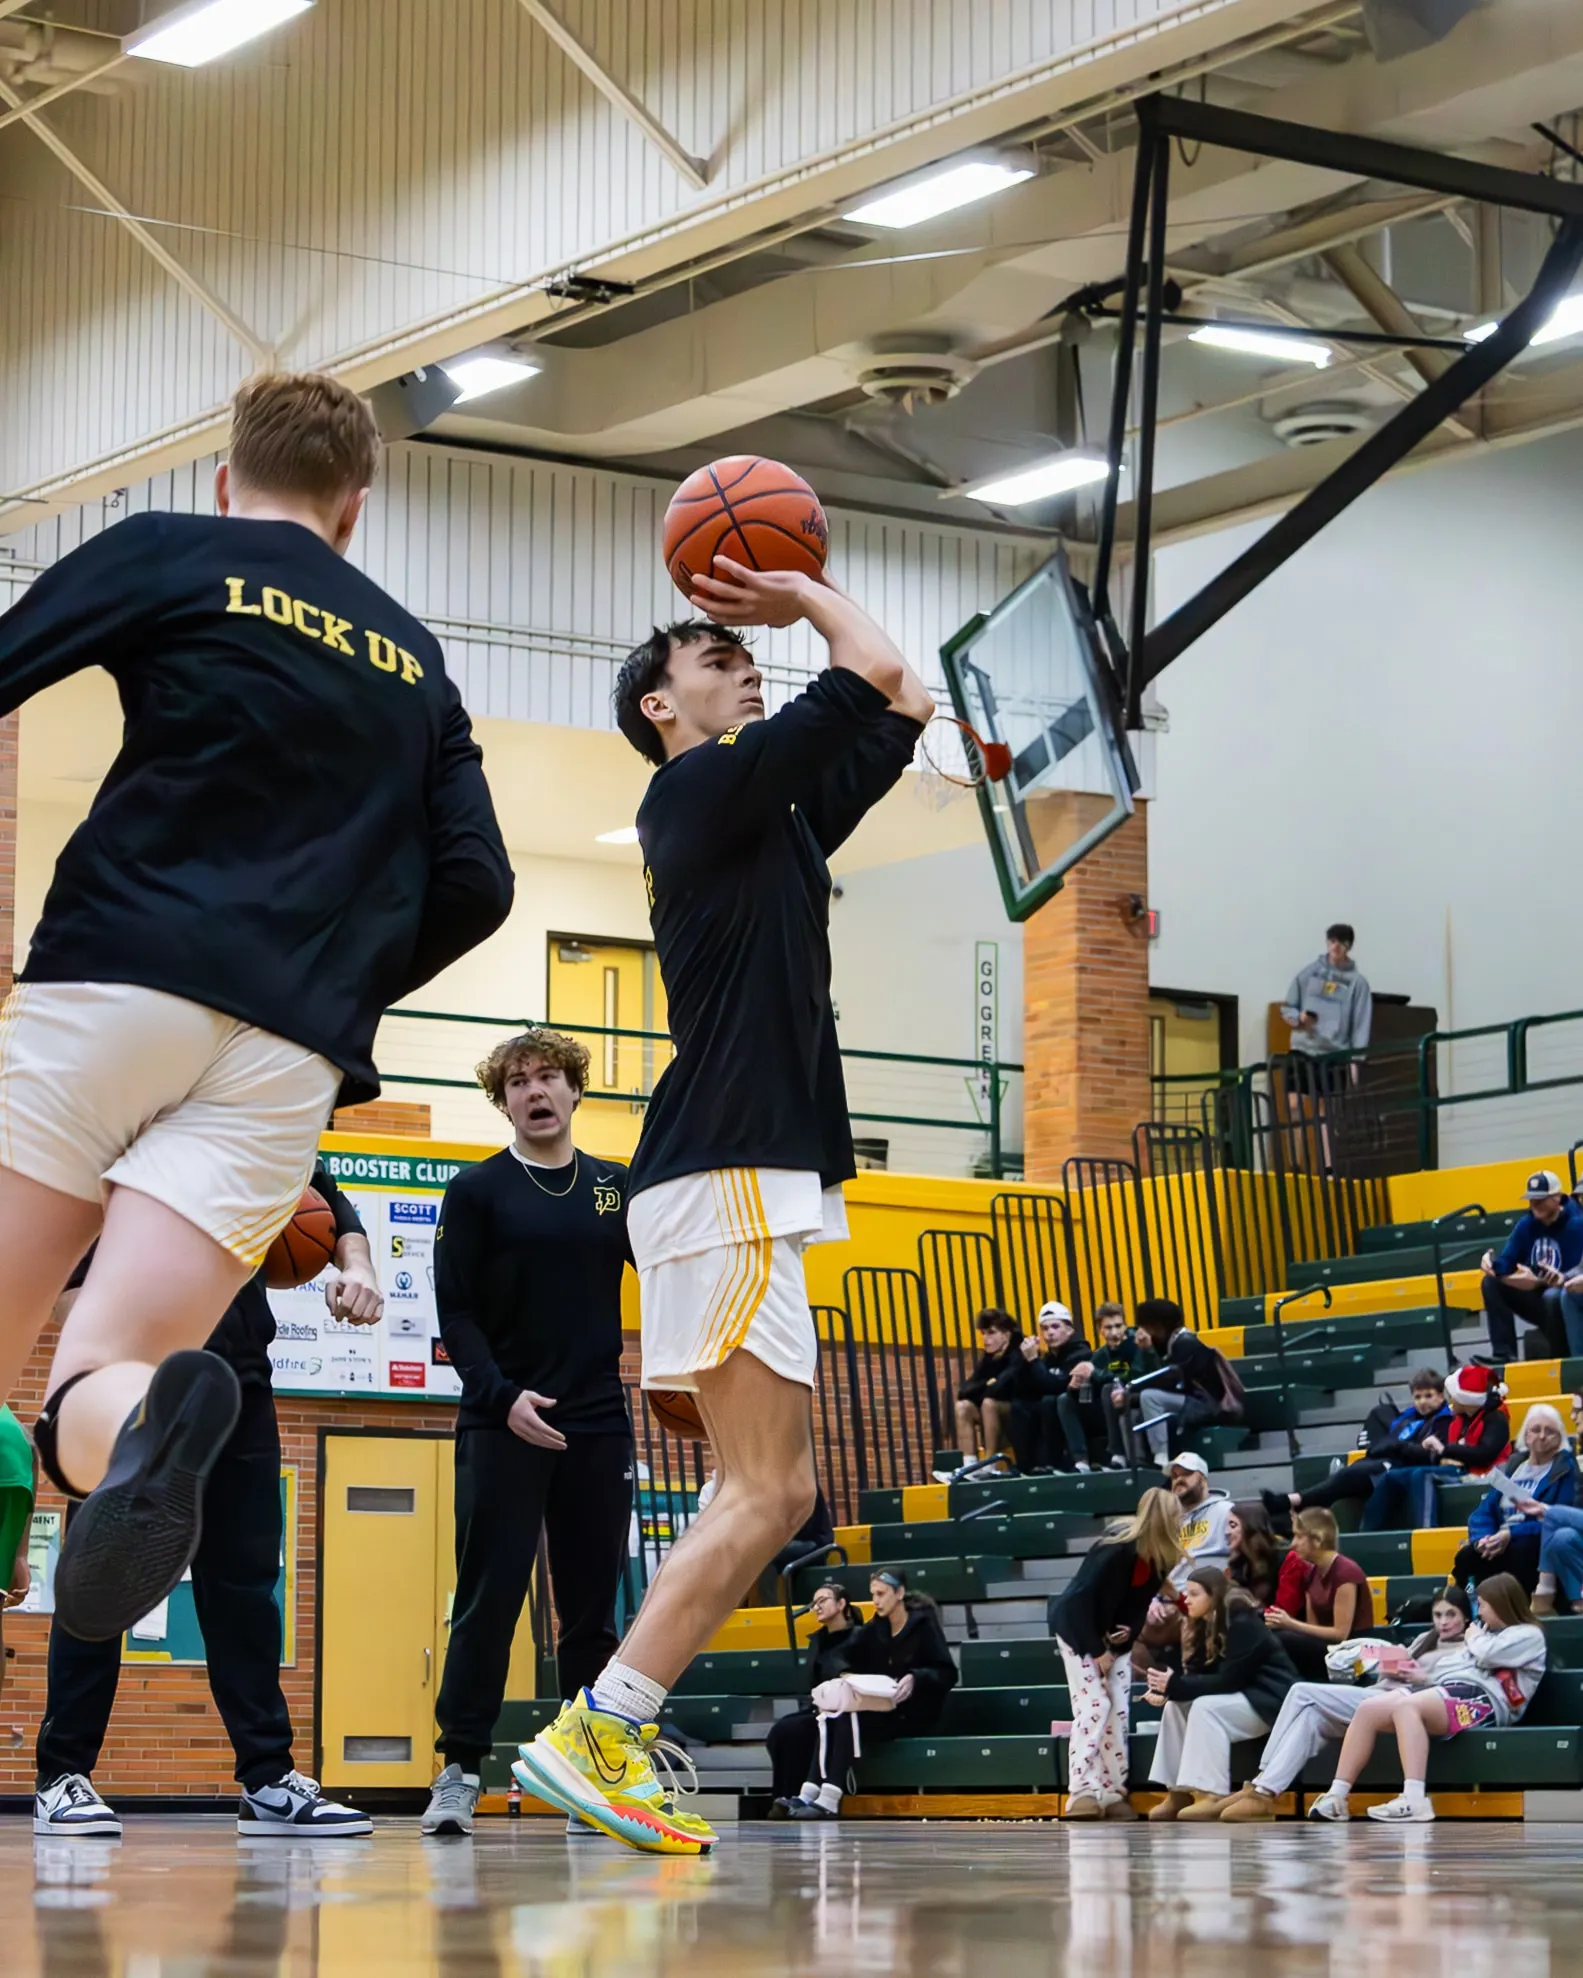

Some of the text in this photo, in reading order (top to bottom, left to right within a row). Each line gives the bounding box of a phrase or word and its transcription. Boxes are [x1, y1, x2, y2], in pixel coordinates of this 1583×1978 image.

[225, 577, 424, 685] LOCK UP
[980, 961, 993, 996] GO
[329, 1156, 411, 1180] BOOSTER
[394, 1203, 432, 1215] SCOTT
